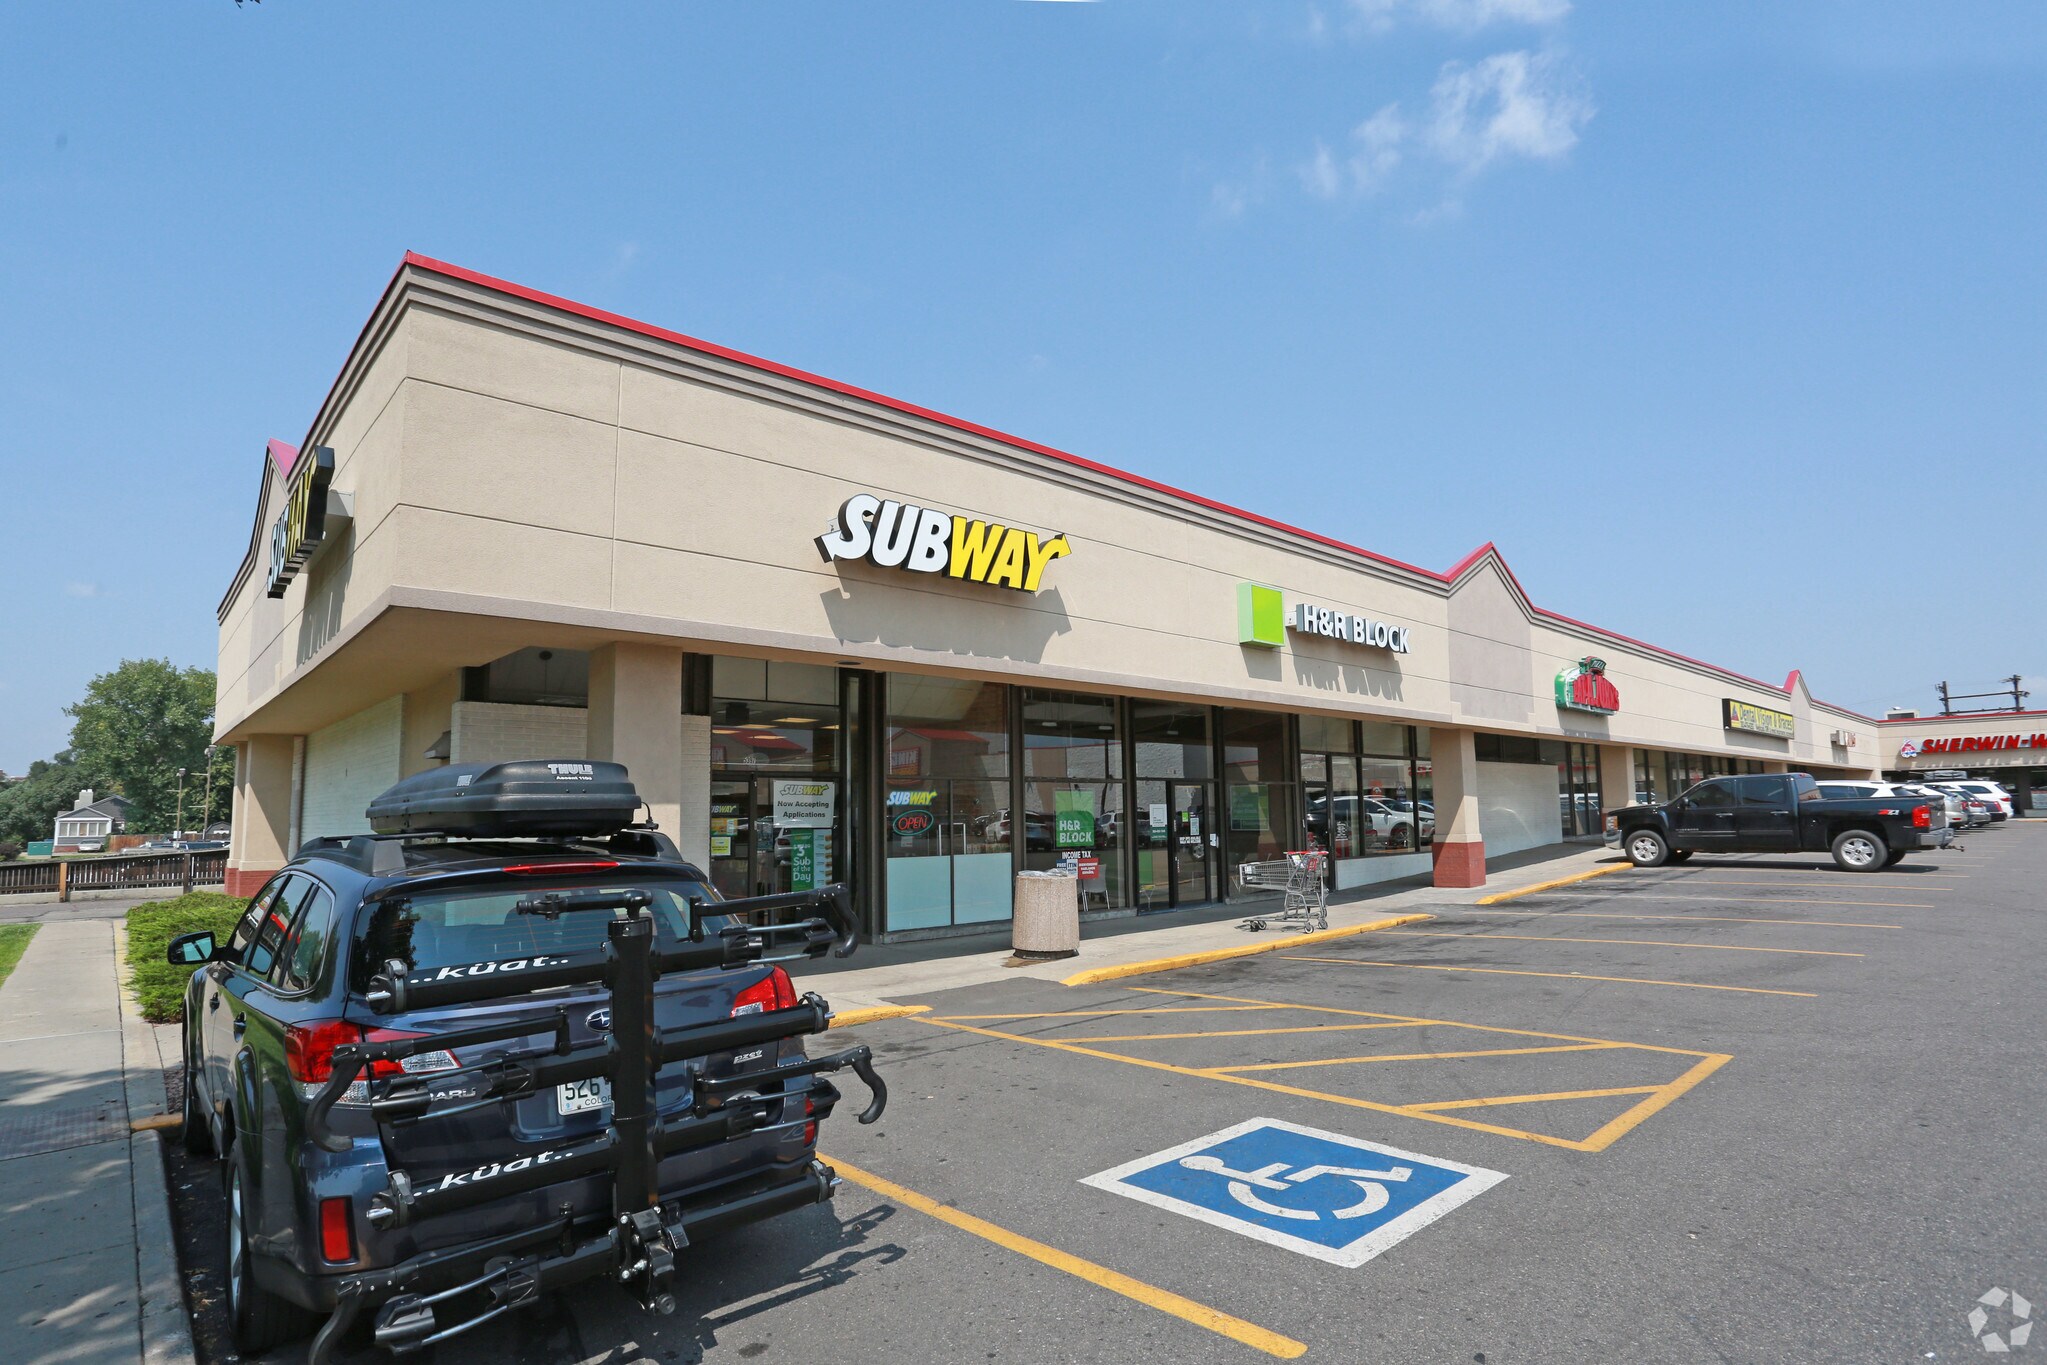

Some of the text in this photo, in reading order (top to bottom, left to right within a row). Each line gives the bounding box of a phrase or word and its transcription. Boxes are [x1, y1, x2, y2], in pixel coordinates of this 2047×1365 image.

[815, 493, 1072, 592] SUBWAY
[1298, 604, 1411, 654] H&R BLOCK
[547, 763, 594, 775] THULE
[780, 783, 830, 796] SUBWAY
[886, 789, 938, 805] SUBWAY
[795, 800, 829, 809] Accepting
[783, 810, 826, 819] Applications
[898, 815, 928, 831] OPEN
[1059, 820, 1080, 831] H&R
[1059, 831, 1093, 844] BLOCK
[1061, 850, 1092, 859] INCOME TAX
[793, 856, 811, 866] Sub
[793, 872, 811, 883] Day
